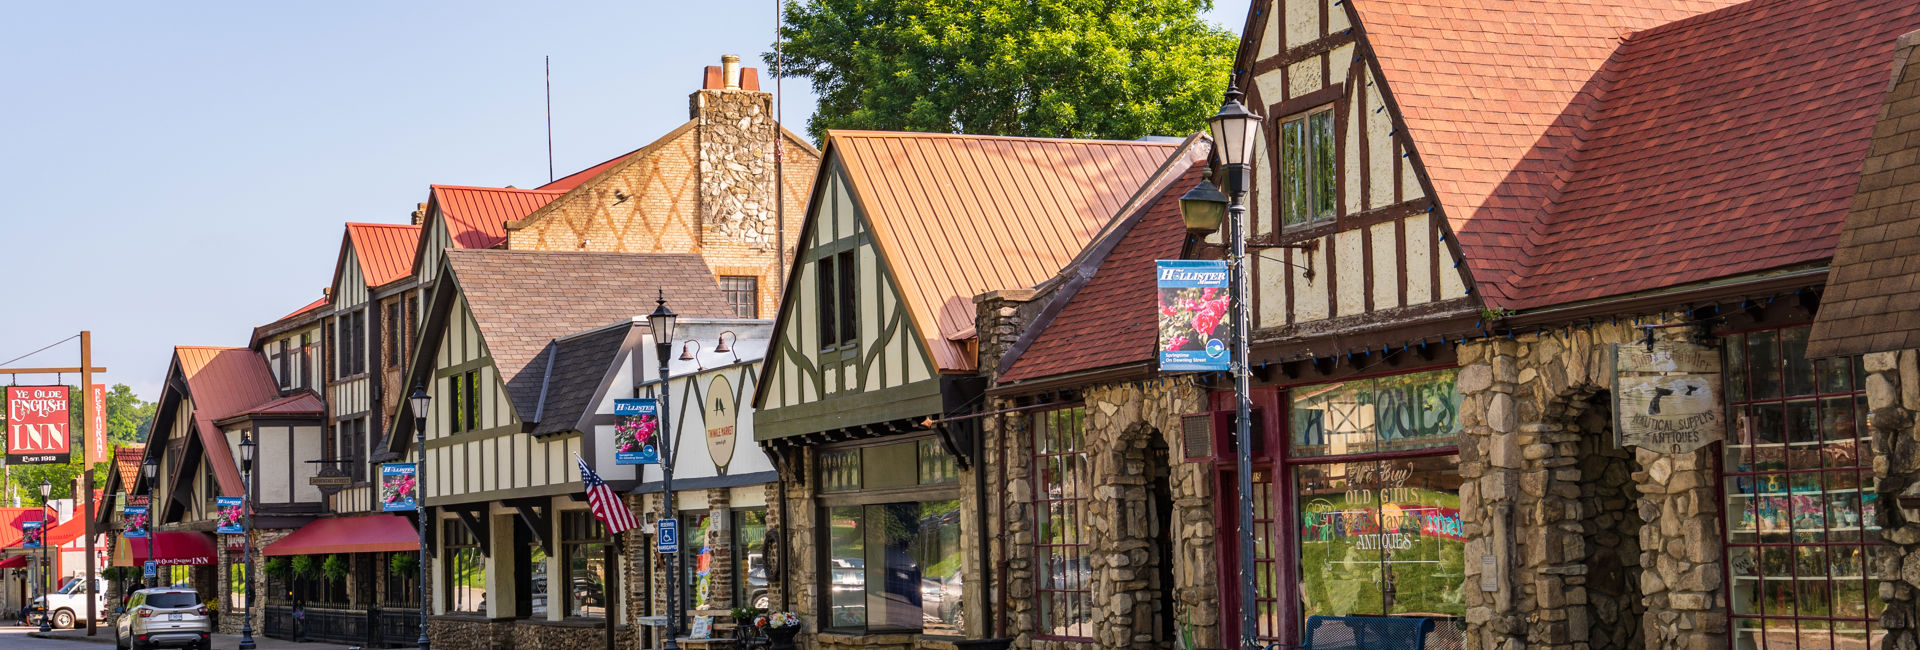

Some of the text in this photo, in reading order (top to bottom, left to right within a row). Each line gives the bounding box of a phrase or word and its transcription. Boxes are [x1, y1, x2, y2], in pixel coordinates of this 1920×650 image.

[1160, 268, 1225, 280] HOLLISTER
[15, 389, 62, 399] YE OLDE
[11, 399, 66, 421] ENGLISH
[94, 388, 103, 458] RESTAURANT
[11, 423, 67, 450] INN
[1652, 431, 1699, 444] ANTIQUES
[1380, 462, 1413, 488] Buy
[1345, 487, 1419, 504] OLD GUNS
[1356, 533, 1412, 550] ANTIQUES
[192, 557, 208, 565] INN
